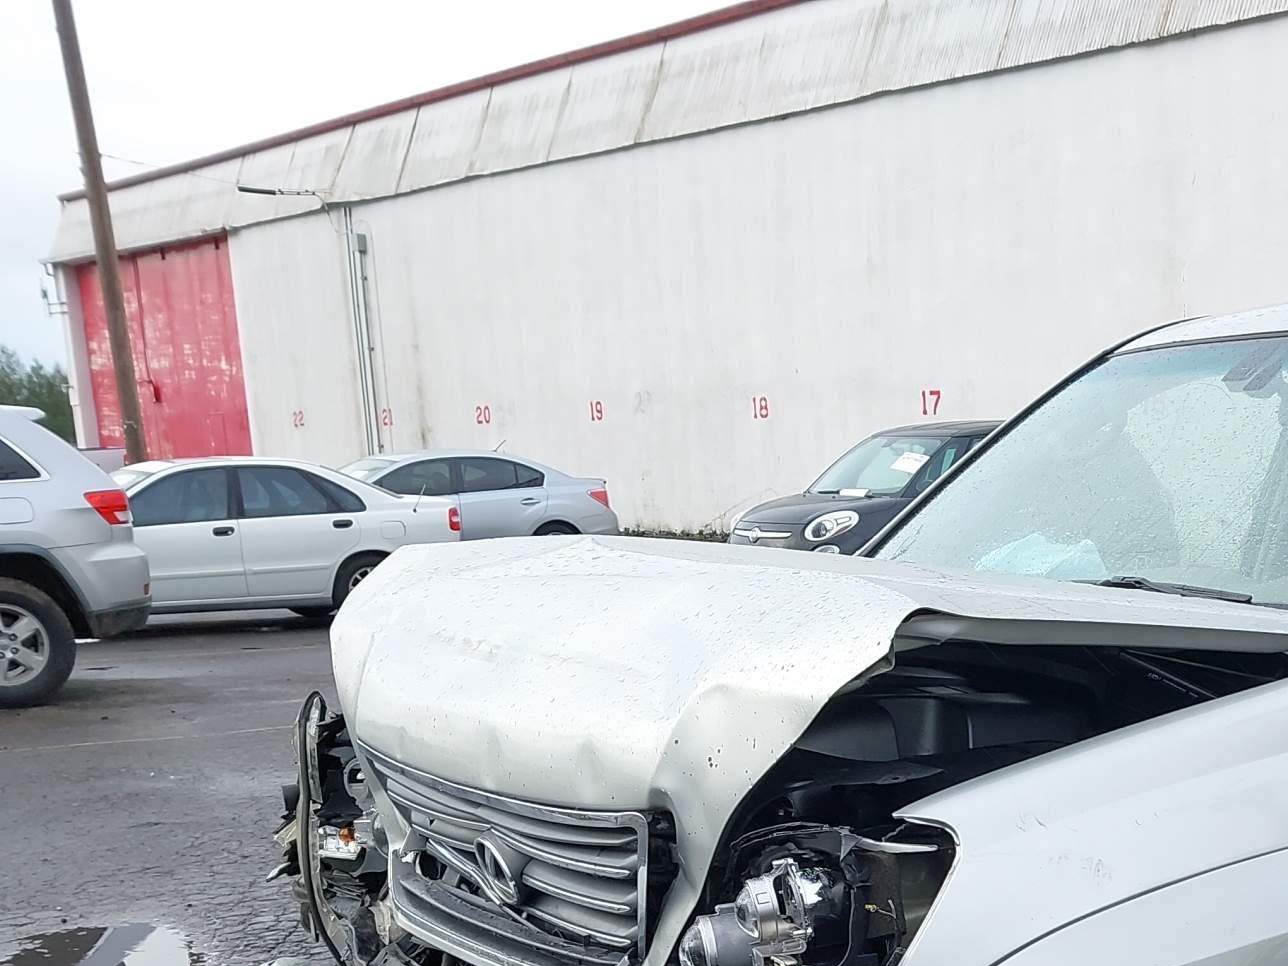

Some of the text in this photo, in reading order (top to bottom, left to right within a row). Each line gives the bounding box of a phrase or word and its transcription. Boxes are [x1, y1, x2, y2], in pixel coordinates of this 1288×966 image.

[589, 400, 604, 421] 19
[752, 396, 769, 419] 18
[920, 389, 942, 416] 17
[291, 409, 305, 428] 22
[381, 407, 393, 427] 21
[474, 405, 491, 424] 20
